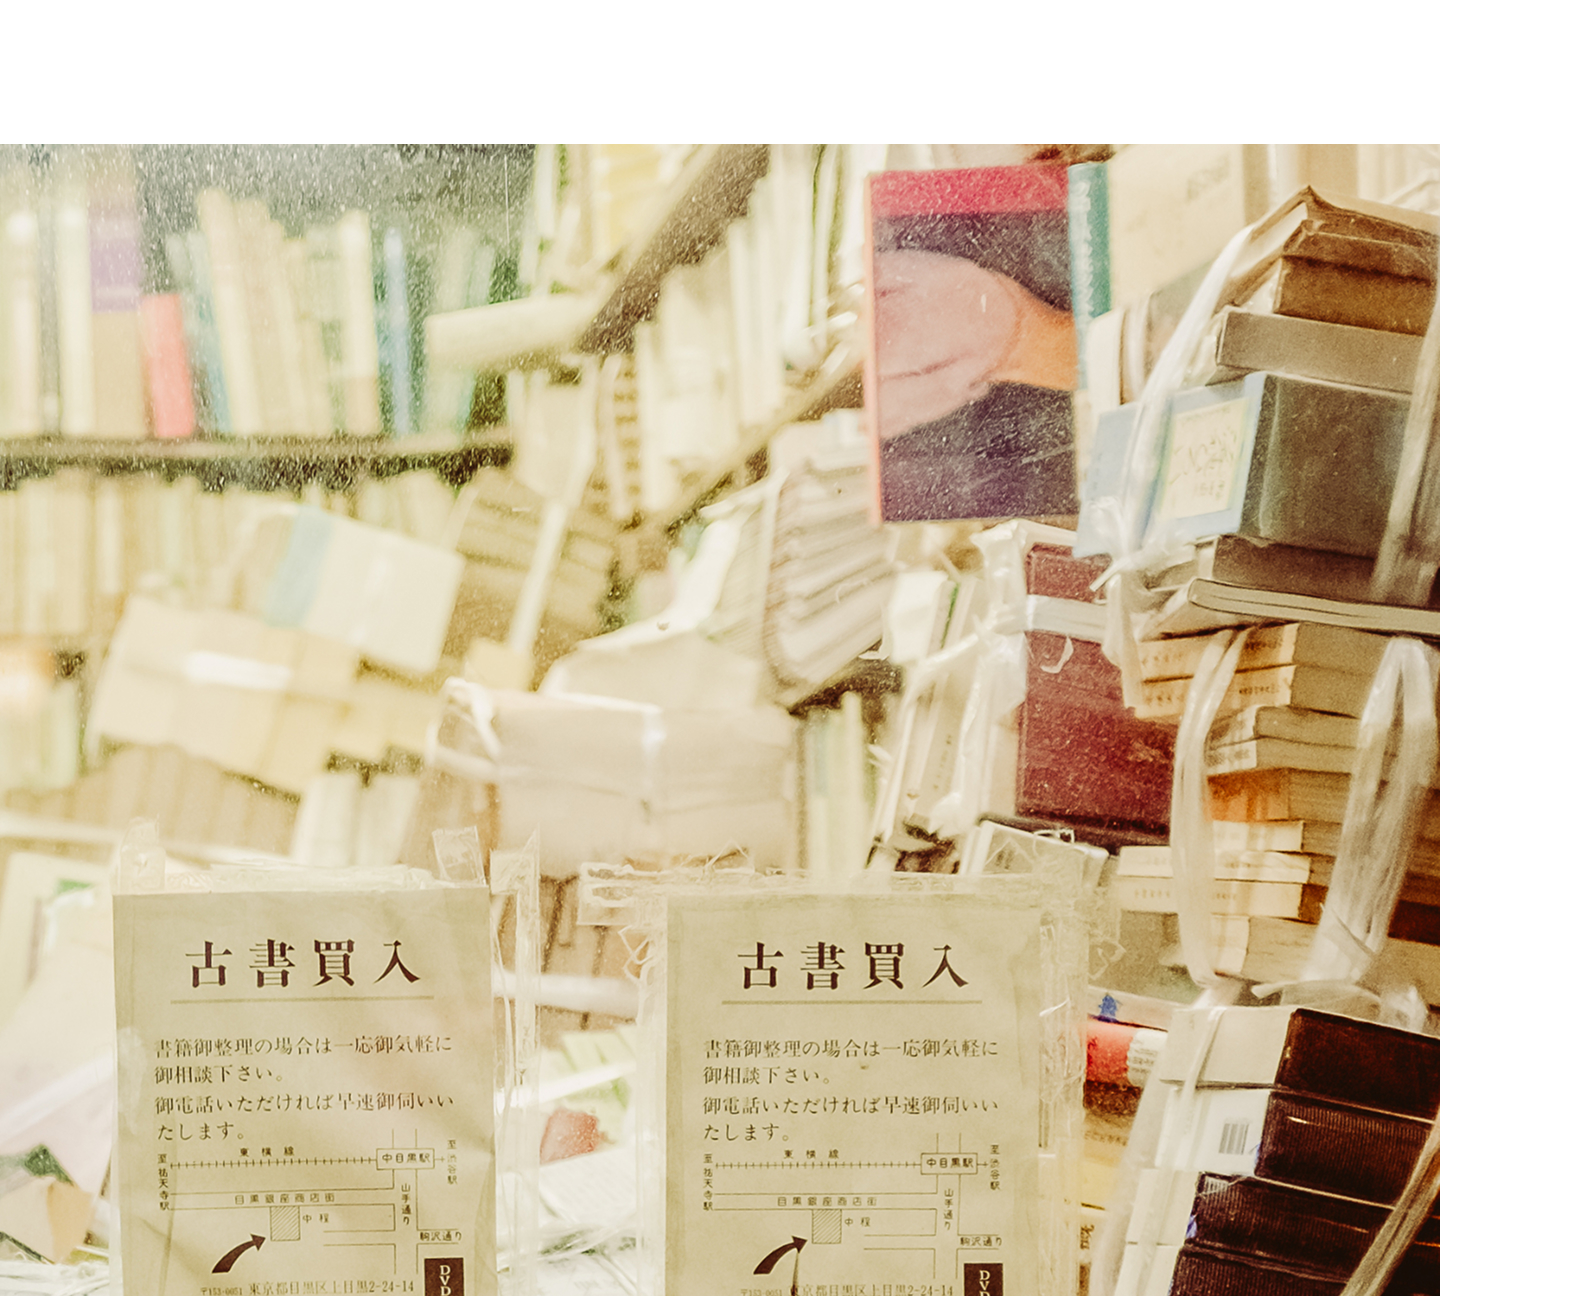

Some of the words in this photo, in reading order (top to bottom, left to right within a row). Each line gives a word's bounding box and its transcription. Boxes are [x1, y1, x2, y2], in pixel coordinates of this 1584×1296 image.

[185, 939, 420, 988] 古書買入
[738, 942, 969, 990] 古書買入
[156, 1036, 452, 1056] 書籍御整理の場合は一応御気軽に
[703, 1038, 999, 1059] 書籍御整理の場合は一応御気軽に
[155, 1065, 284, 1084] 御相談下さい。
[703, 1065, 832, 1086] 御相談下さい。
[156, 1092, 455, 1114] 御電話いただければ早速御伺いい
[703, 1096, 999, 1117] 御電話いただければ早速御伺いい
[158, 1122, 246, 1142] たします。
[703, 1122, 790, 1142] たします。
[240, 1146, 295, 1157] 東横線
[382, 1153, 430, 1163] 中目黒駅
[784, 1149, 839, 1159] 東横線
[927, 1158, 974, 1169] 中目黒駅
[235, 1192, 335, 1205] 目黒銀座商店街
[401, 1183, 411, 1225] 山手通り
[778, 1196, 877, 1207] 目黒銀座商店街
[943, 1188, 954, 1230] 山手通り
[420, 1231, 462, 1242] 駒沢通り
[960, 1236, 1003, 1247] 駒沢通り
